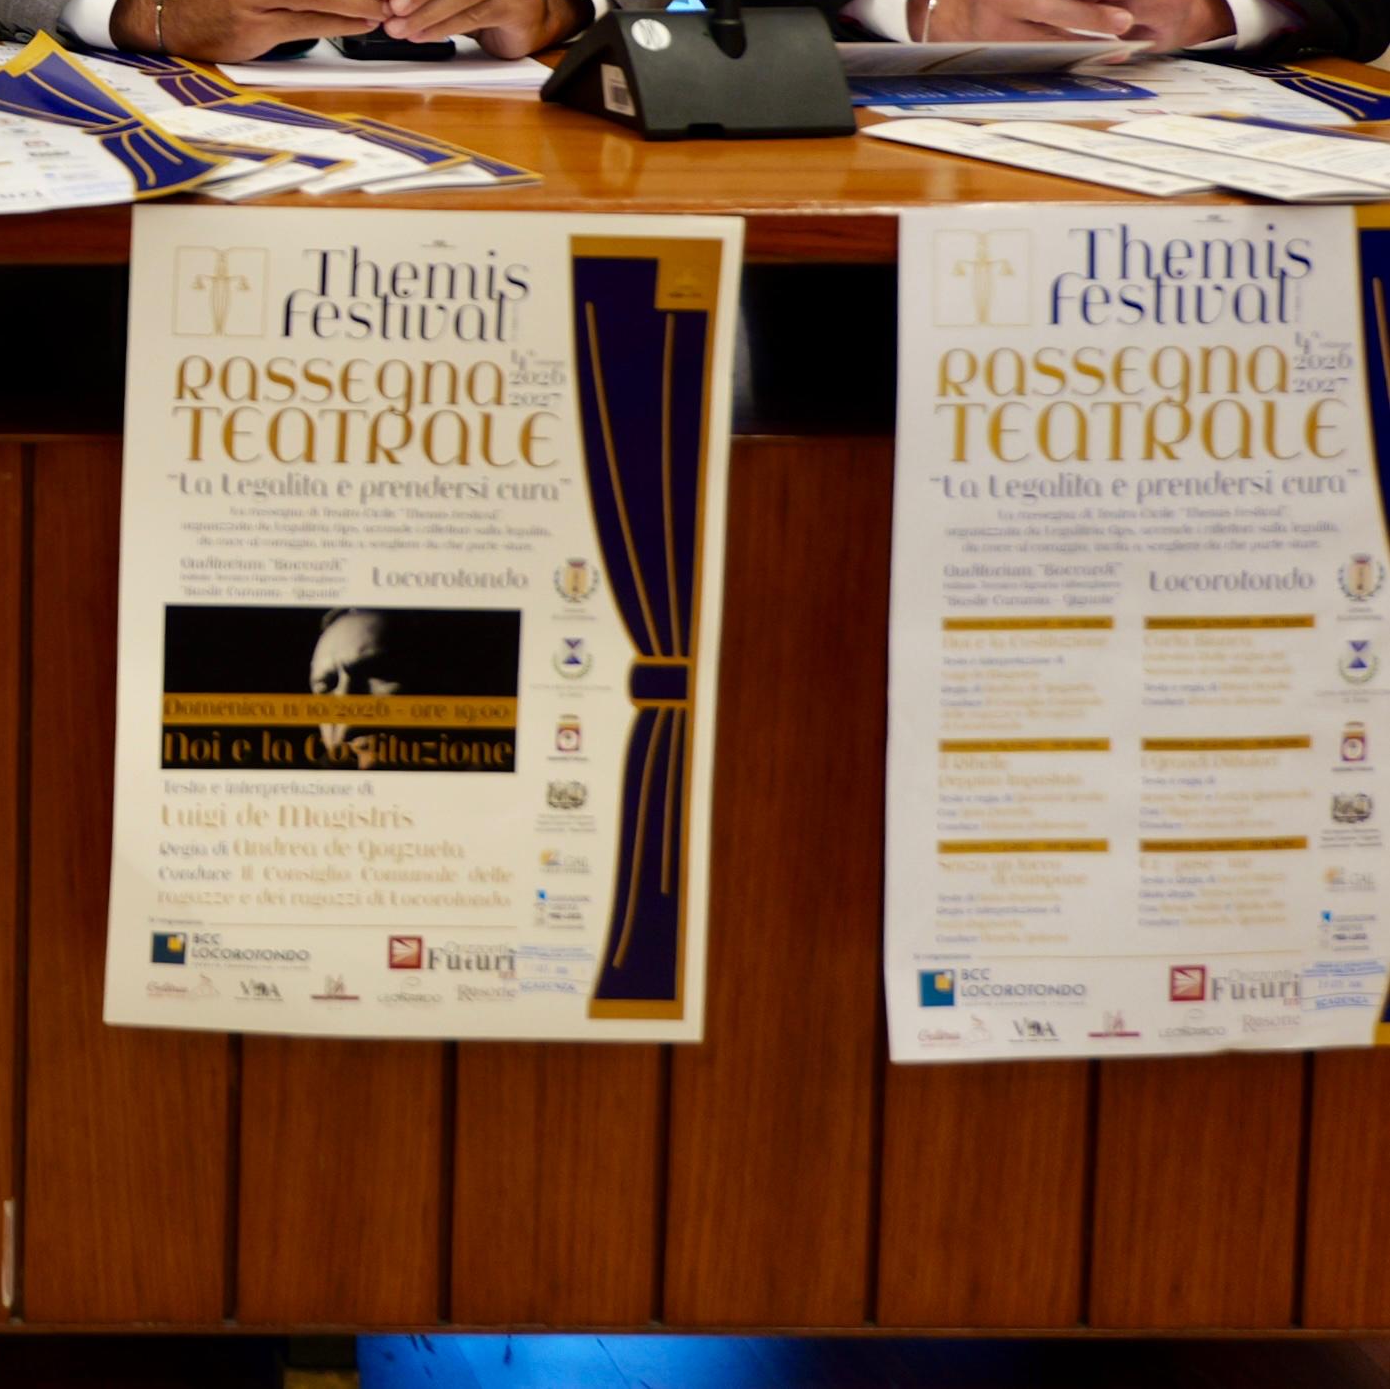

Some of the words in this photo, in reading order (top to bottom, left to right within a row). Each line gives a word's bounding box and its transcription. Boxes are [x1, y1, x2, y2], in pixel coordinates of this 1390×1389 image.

[1068, 223, 1312, 281] Themis
[304, 246, 531, 301] Themis
[1048, 269, 1290, 326] festival
[281, 287, 508, 343] festival
[361, 473, 491, 506] prendersi
[1137, 470, 1273, 504] prendersi
[372, 565, 529, 590] Locorotondo
[1149, 567, 1316, 593] Locorotondo
[163, 697, 275, 719] Domenica
[164, 731, 221, 761] Noi
[232, 737, 252, 761] e
[263, 731, 294, 762] la
[161, 804, 228, 831] Luigi
[236, 804, 269, 828] de
[279, 804, 415, 831] Magistris
[192, 932, 221, 946] BCC
[191, 947, 311, 962] LOCOROTONDO
[427, 945, 515, 972] Futuri
[961, 968, 990, 982] BCC
[1212, 973, 1301, 1004] Futuri
[961, 983, 1086, 998] LOCOROTONDO
